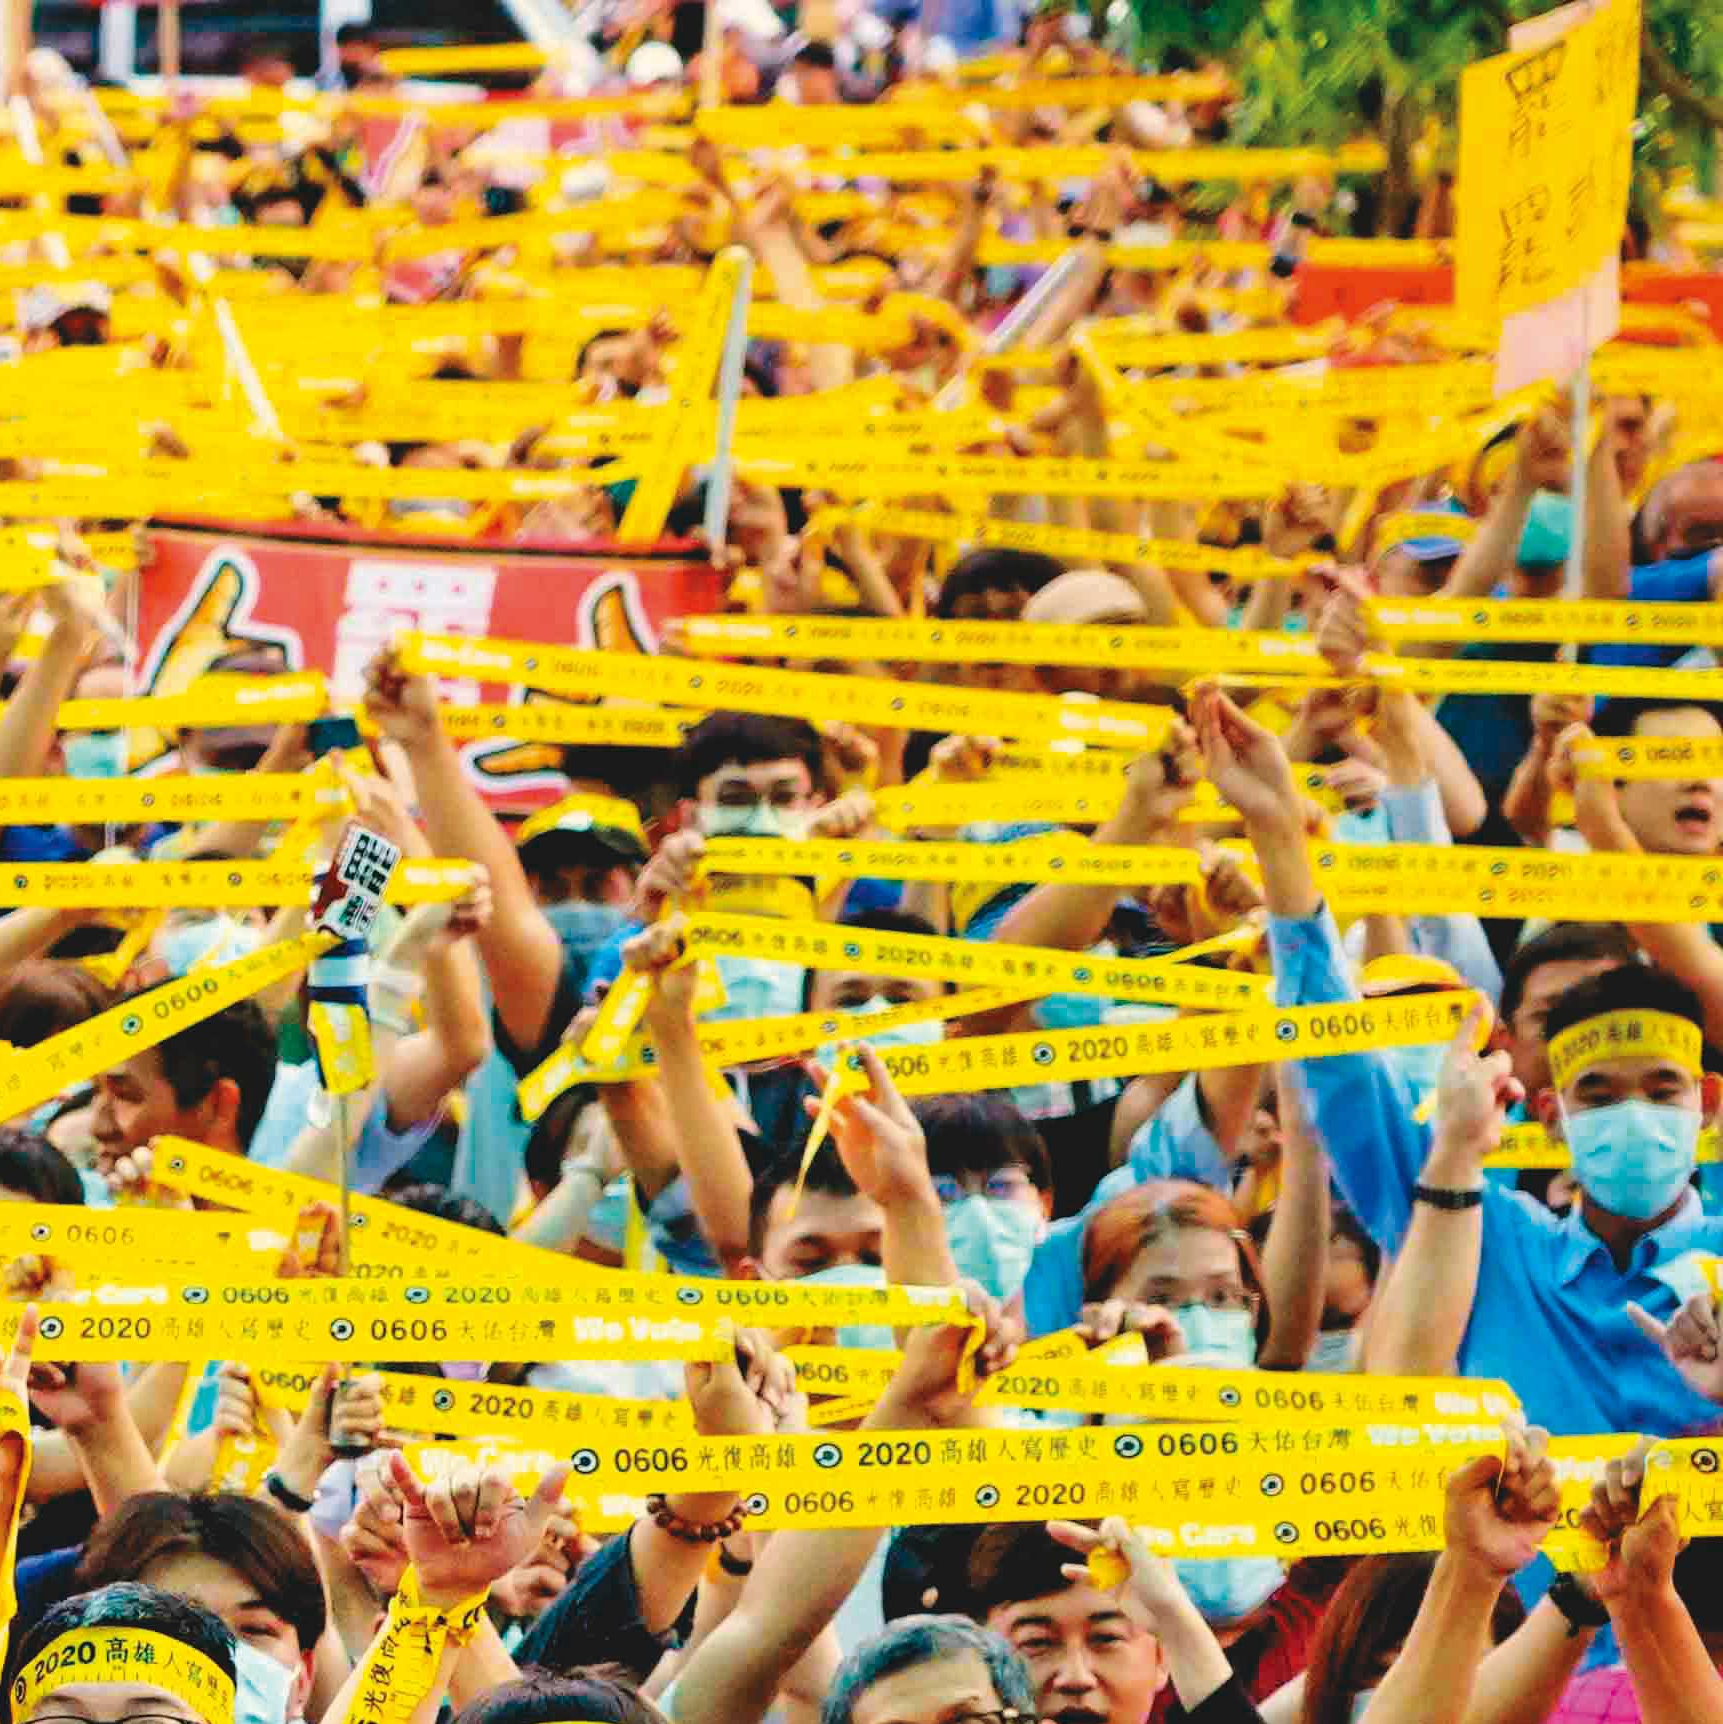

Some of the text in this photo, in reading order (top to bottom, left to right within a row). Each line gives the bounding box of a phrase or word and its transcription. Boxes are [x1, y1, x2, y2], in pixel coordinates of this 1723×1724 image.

[874, 943, 932, 965] 2020
[153, 977, 219, 1021] 0606
[1068, 1014, 1375, 1062] 2020 0606
[66, 1225, 136, 1245] 0606
[381, 1221, 437, 1251] 2020
[222, 1286, 789, 1306] 0606 2020 0606
[79, 1317, 151, 1340] 2020
[370, 1319, 447, 1341] 0606
[470, 1394, 533, 1419] 2020
[995, 1375, 1060, 1397] 2020
[1255, 1391, 1324, 1412] 0606
[614, 1448, 687, 1472] 0606
[697, 1442, 796, 1472] 光復高雄
[857, 1442, 931, 1467] 2020
[1157, 1432, 1239, 1458] 0606
[784, 1472, 1375, 1514] 0606 2020 0606
[1314, 1519, 1386, 1542] 0606
[32, 1641, 97, 1686] 2020
